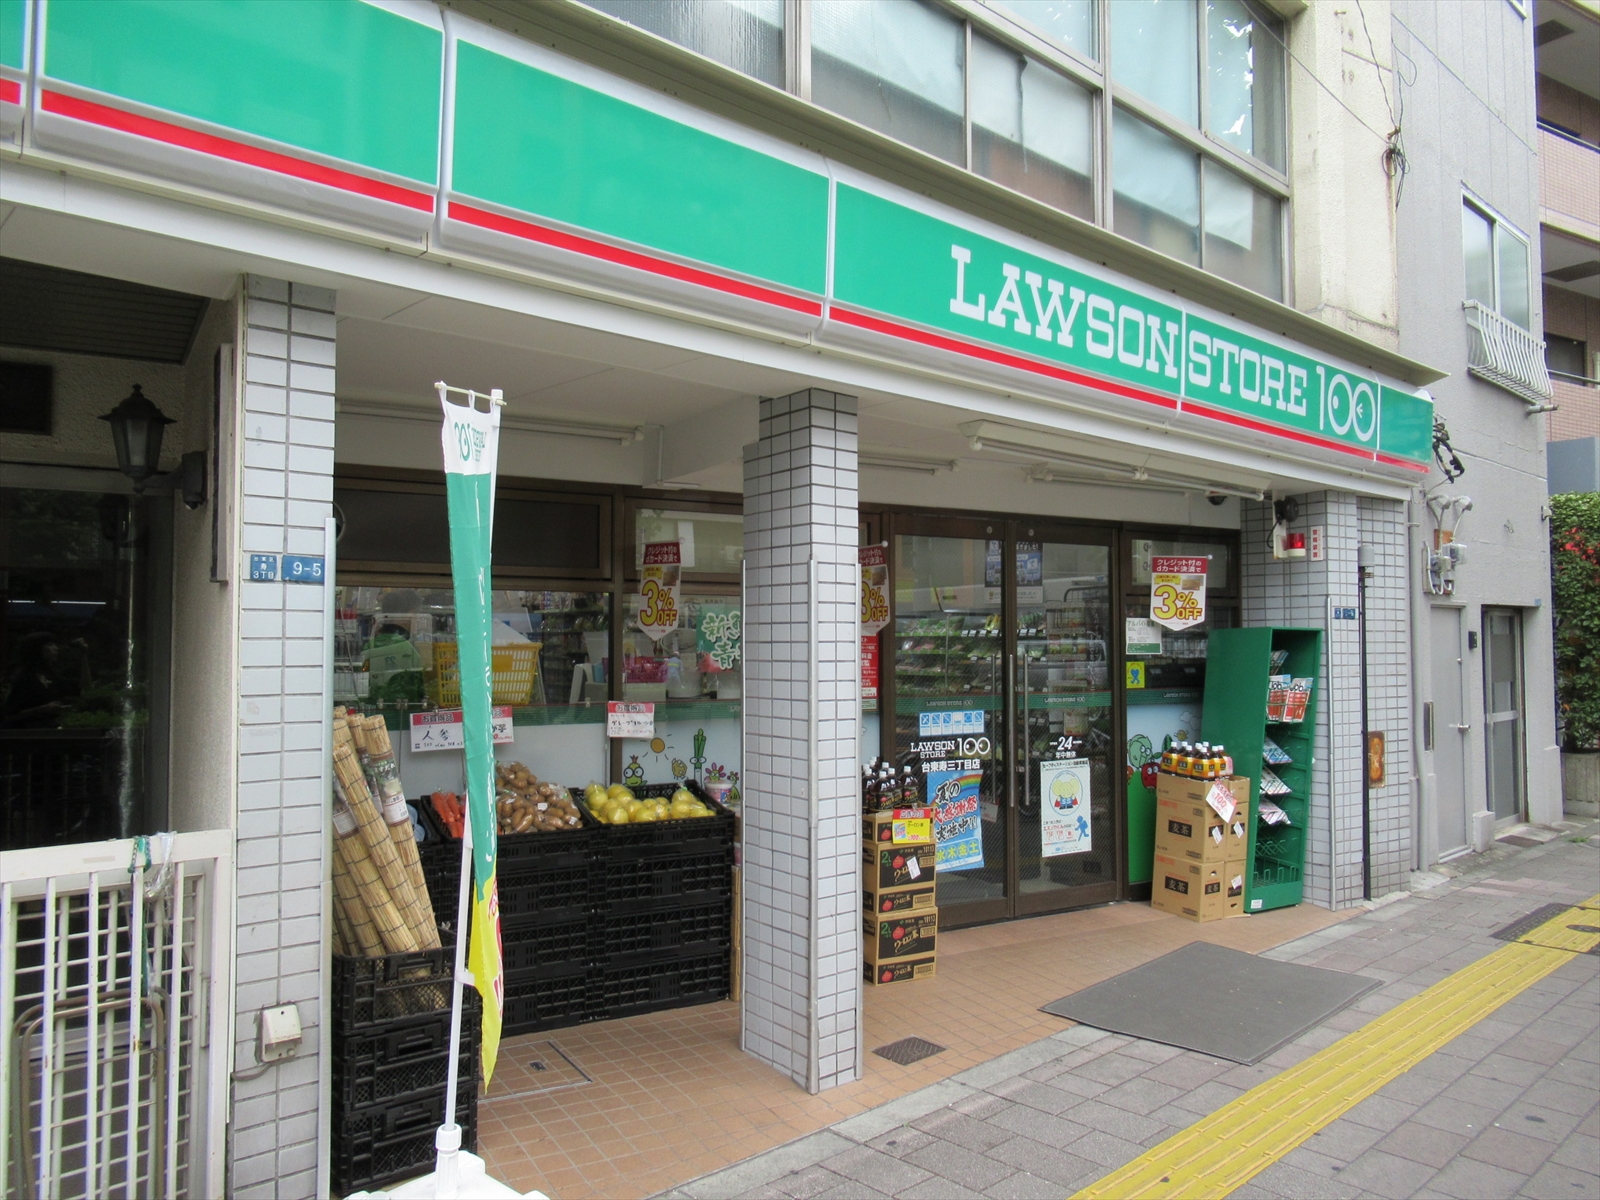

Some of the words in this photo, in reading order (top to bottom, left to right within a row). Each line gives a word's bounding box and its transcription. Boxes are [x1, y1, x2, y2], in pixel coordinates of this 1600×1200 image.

[950, 244, 1178, 378] LAWSON
[1189, 330, 1307, 416] STORE
[1316, 365, 1376, 442] 100
[253, 571, 275, 579] 3丁目
[293, 562, 322, 577] 9-5
[656, 609, 678, 626] OFF
[871, 606, 888, 622] OFF
[1176, 607, 1203, 620] OFF
[710, 640, 740, 670] 青
[910, 741, 956, 752] LAWSON
[956, 737, 991, 757] 100
[1057, 735, 1073, 750] 24
[920, 750, 946, 758] STORE
[921, 759, 981, 773] 台東寿三丁目店
[936, 781, 961, 804] 夏の
[1172, 824, 1190, 836] 麦茶
[1168, 880, 1187, 892] 麦茶
